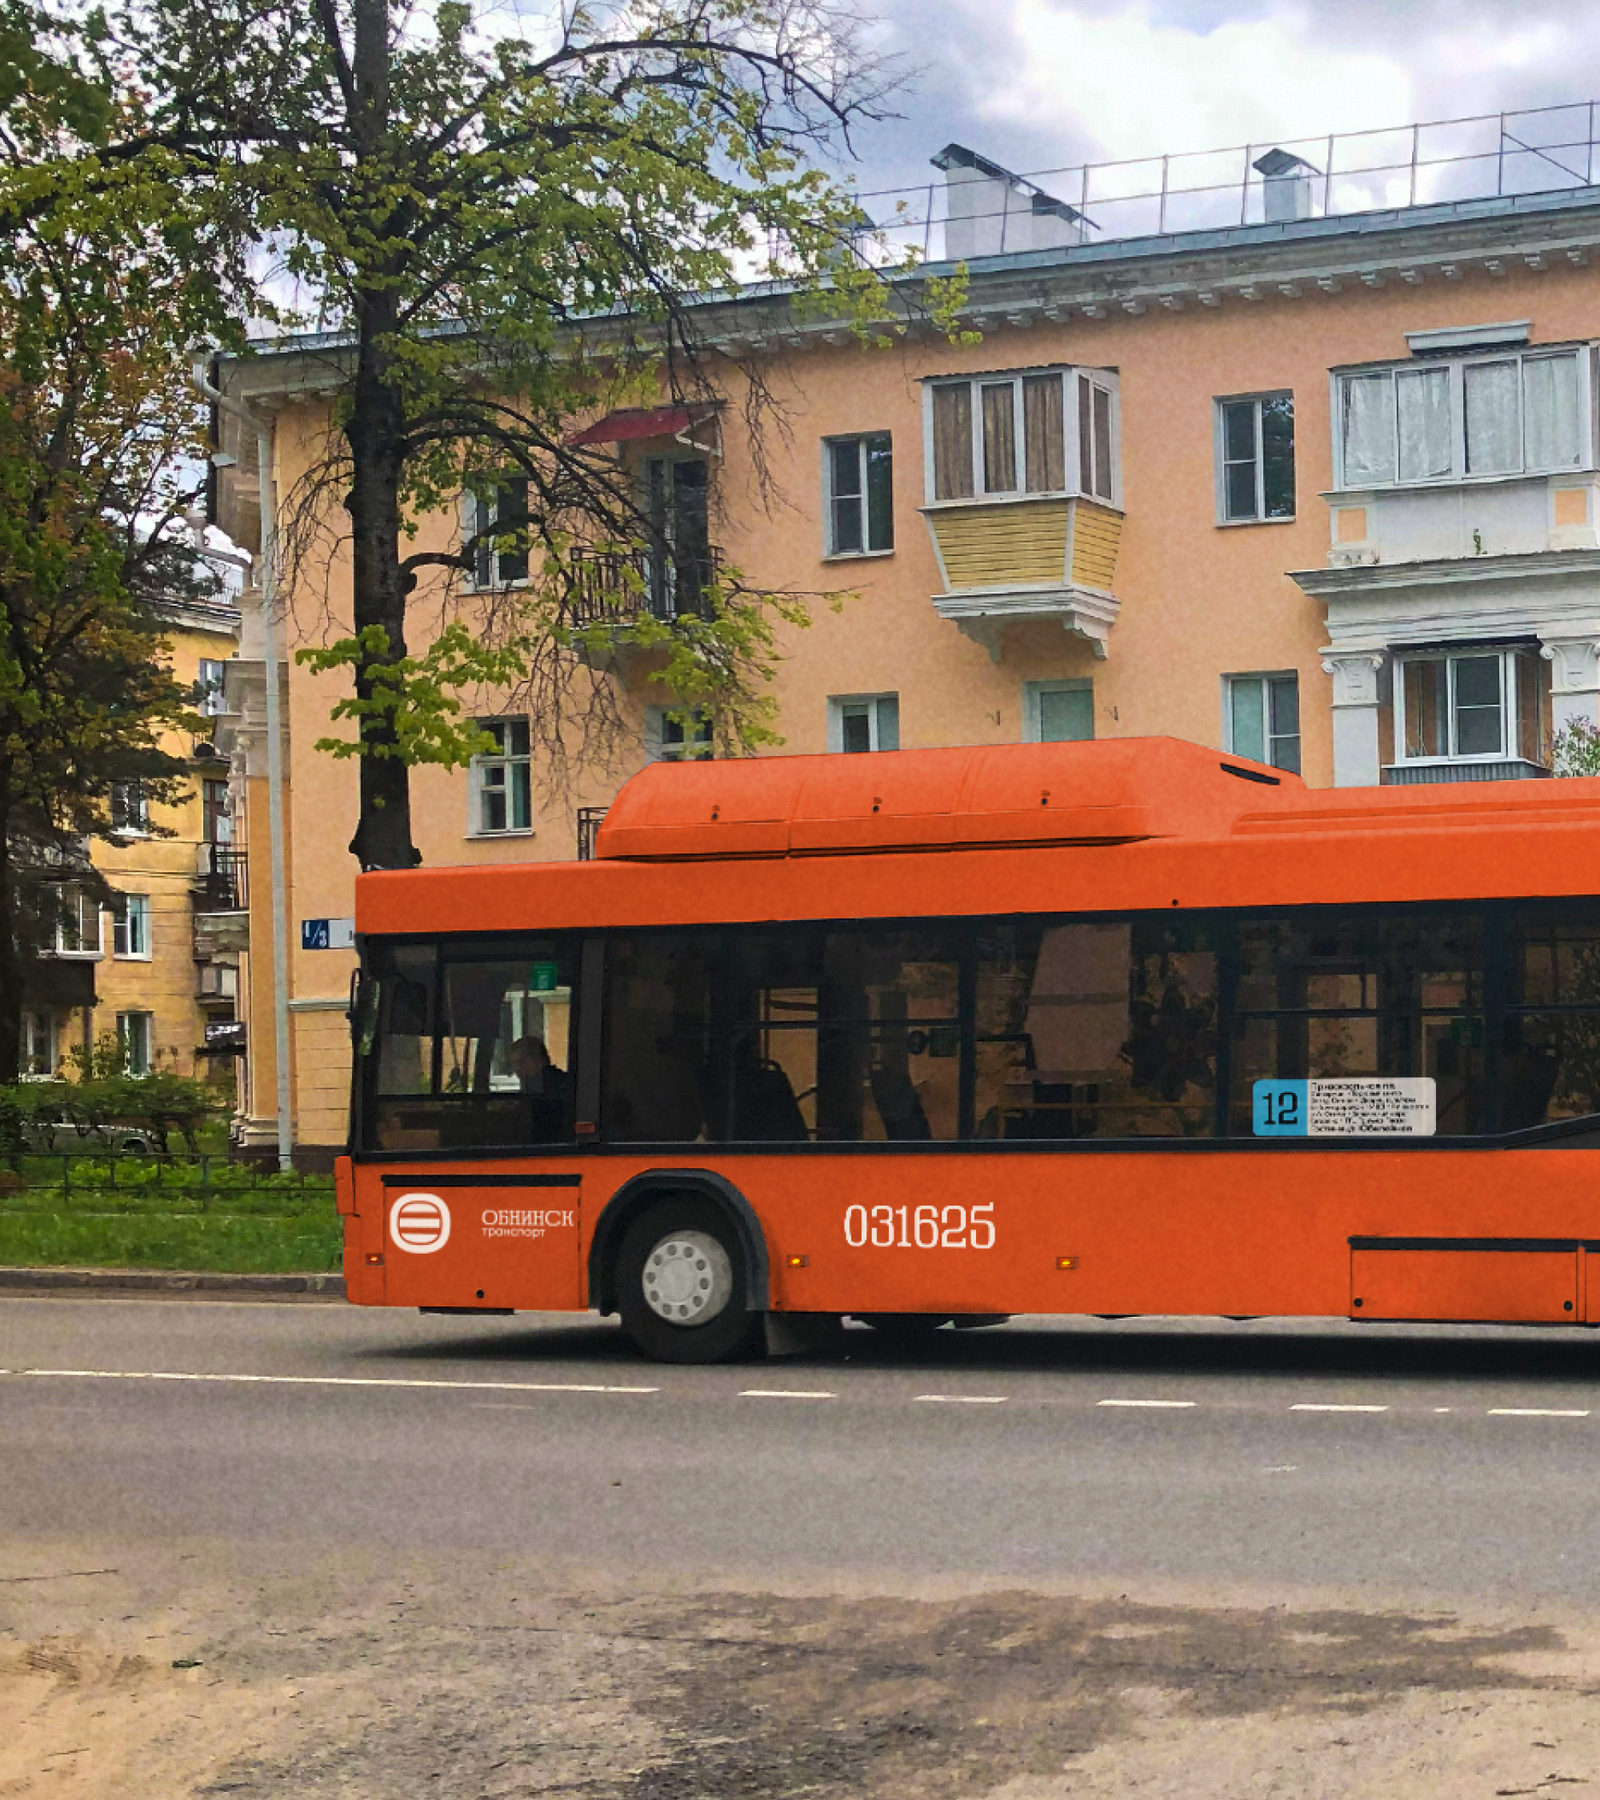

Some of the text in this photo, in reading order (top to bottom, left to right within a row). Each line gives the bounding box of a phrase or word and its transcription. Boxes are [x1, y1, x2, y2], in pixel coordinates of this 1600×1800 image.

[1262, 1091, 1298, 1125] 12
[481, 1209, 574, 1227] ОБНИНСК
[844, 1202, 996, 1249] 031625
[481, 1227, 546, 1240] транспорт
